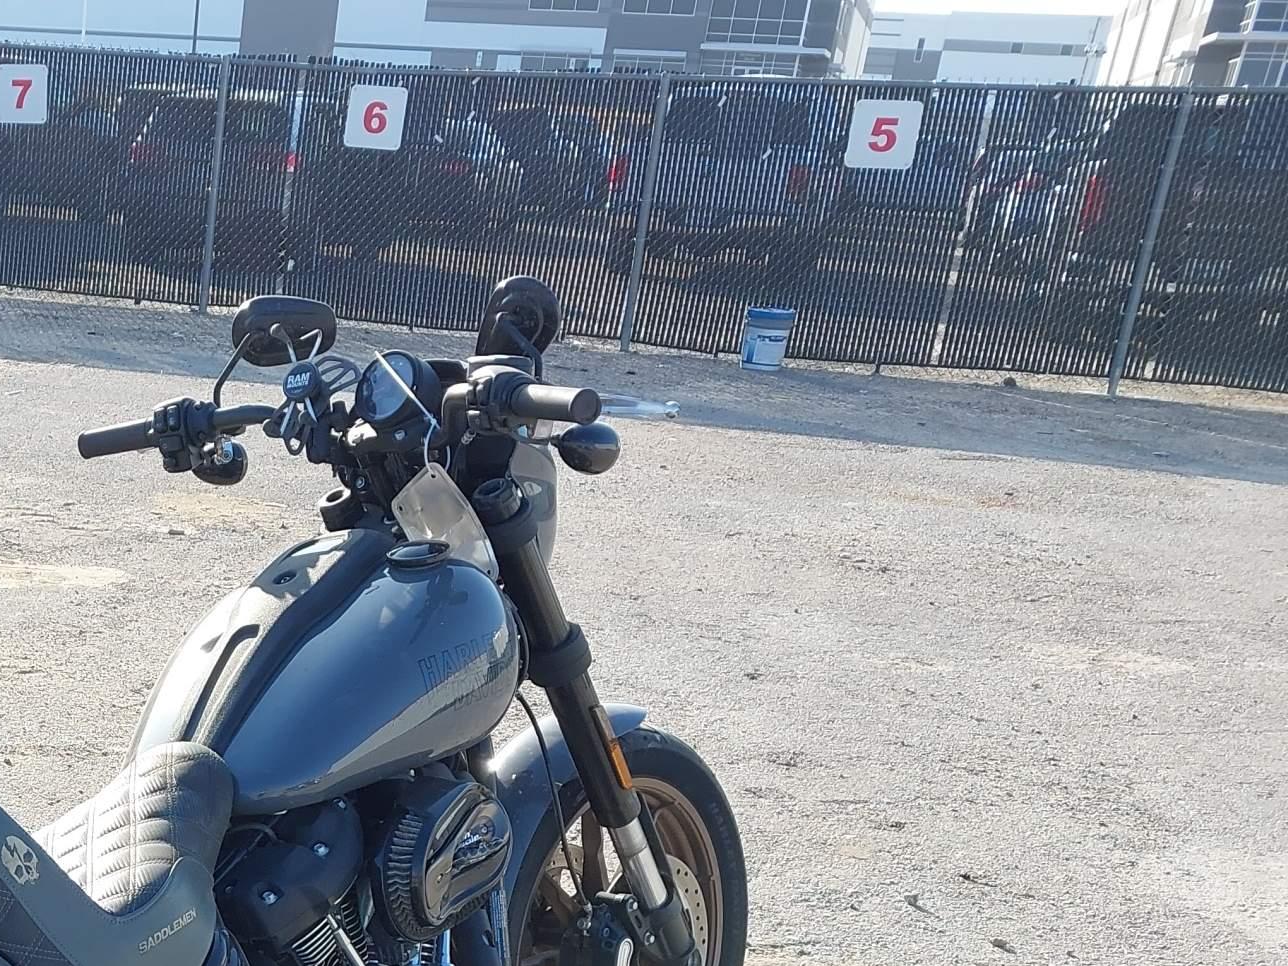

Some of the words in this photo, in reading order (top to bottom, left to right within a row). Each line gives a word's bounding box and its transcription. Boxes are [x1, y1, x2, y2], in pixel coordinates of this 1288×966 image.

[11, 79, 33, 109] 7
[363, 101, 388, 134] 6
[868, 117, 900, 153] 5
[288, 372, 310, 383] RAM
[138, 906, 197, 954] SADDLEMEN
